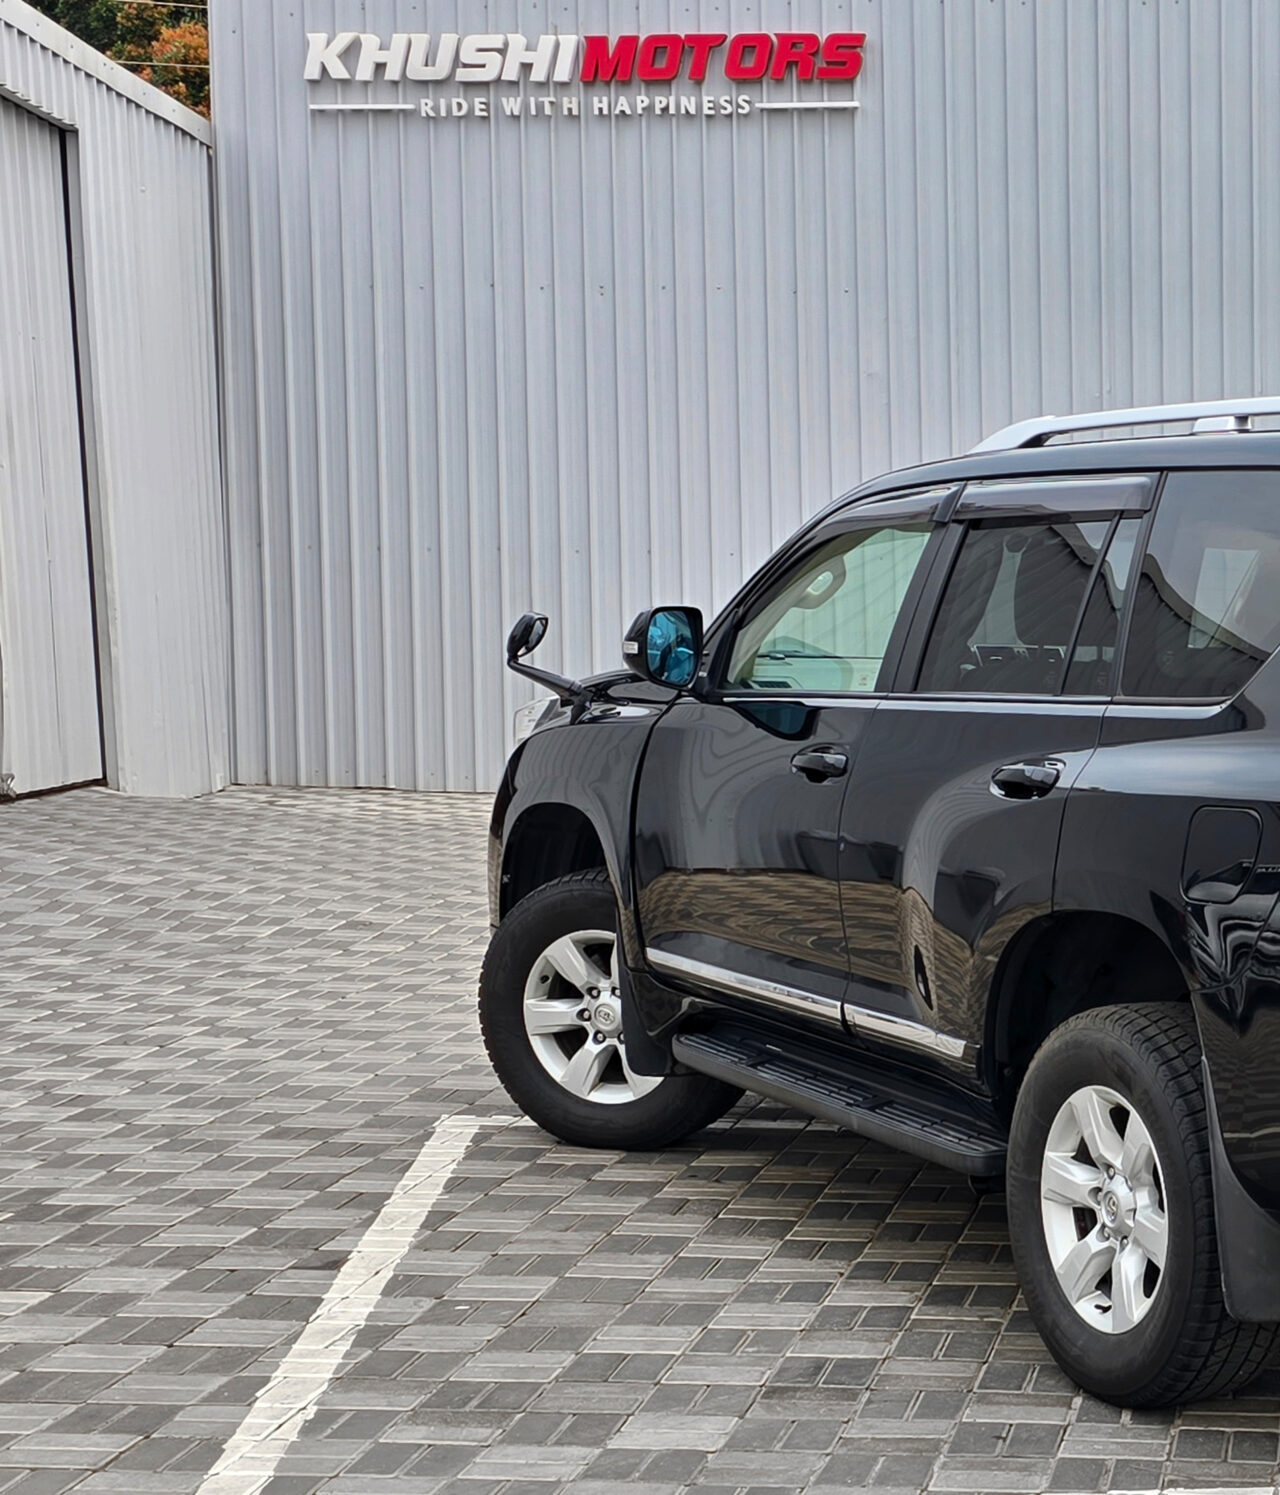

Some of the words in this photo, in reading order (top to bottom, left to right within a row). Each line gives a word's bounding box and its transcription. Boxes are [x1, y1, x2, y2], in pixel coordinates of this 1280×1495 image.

[303, 31, 867, 82] KHUSHIMOTORS
[419, 97, 489, 118] RIDE
[502, 97, 579, 117] WITH
[593, 95, 752, 116] HAPPINESS
